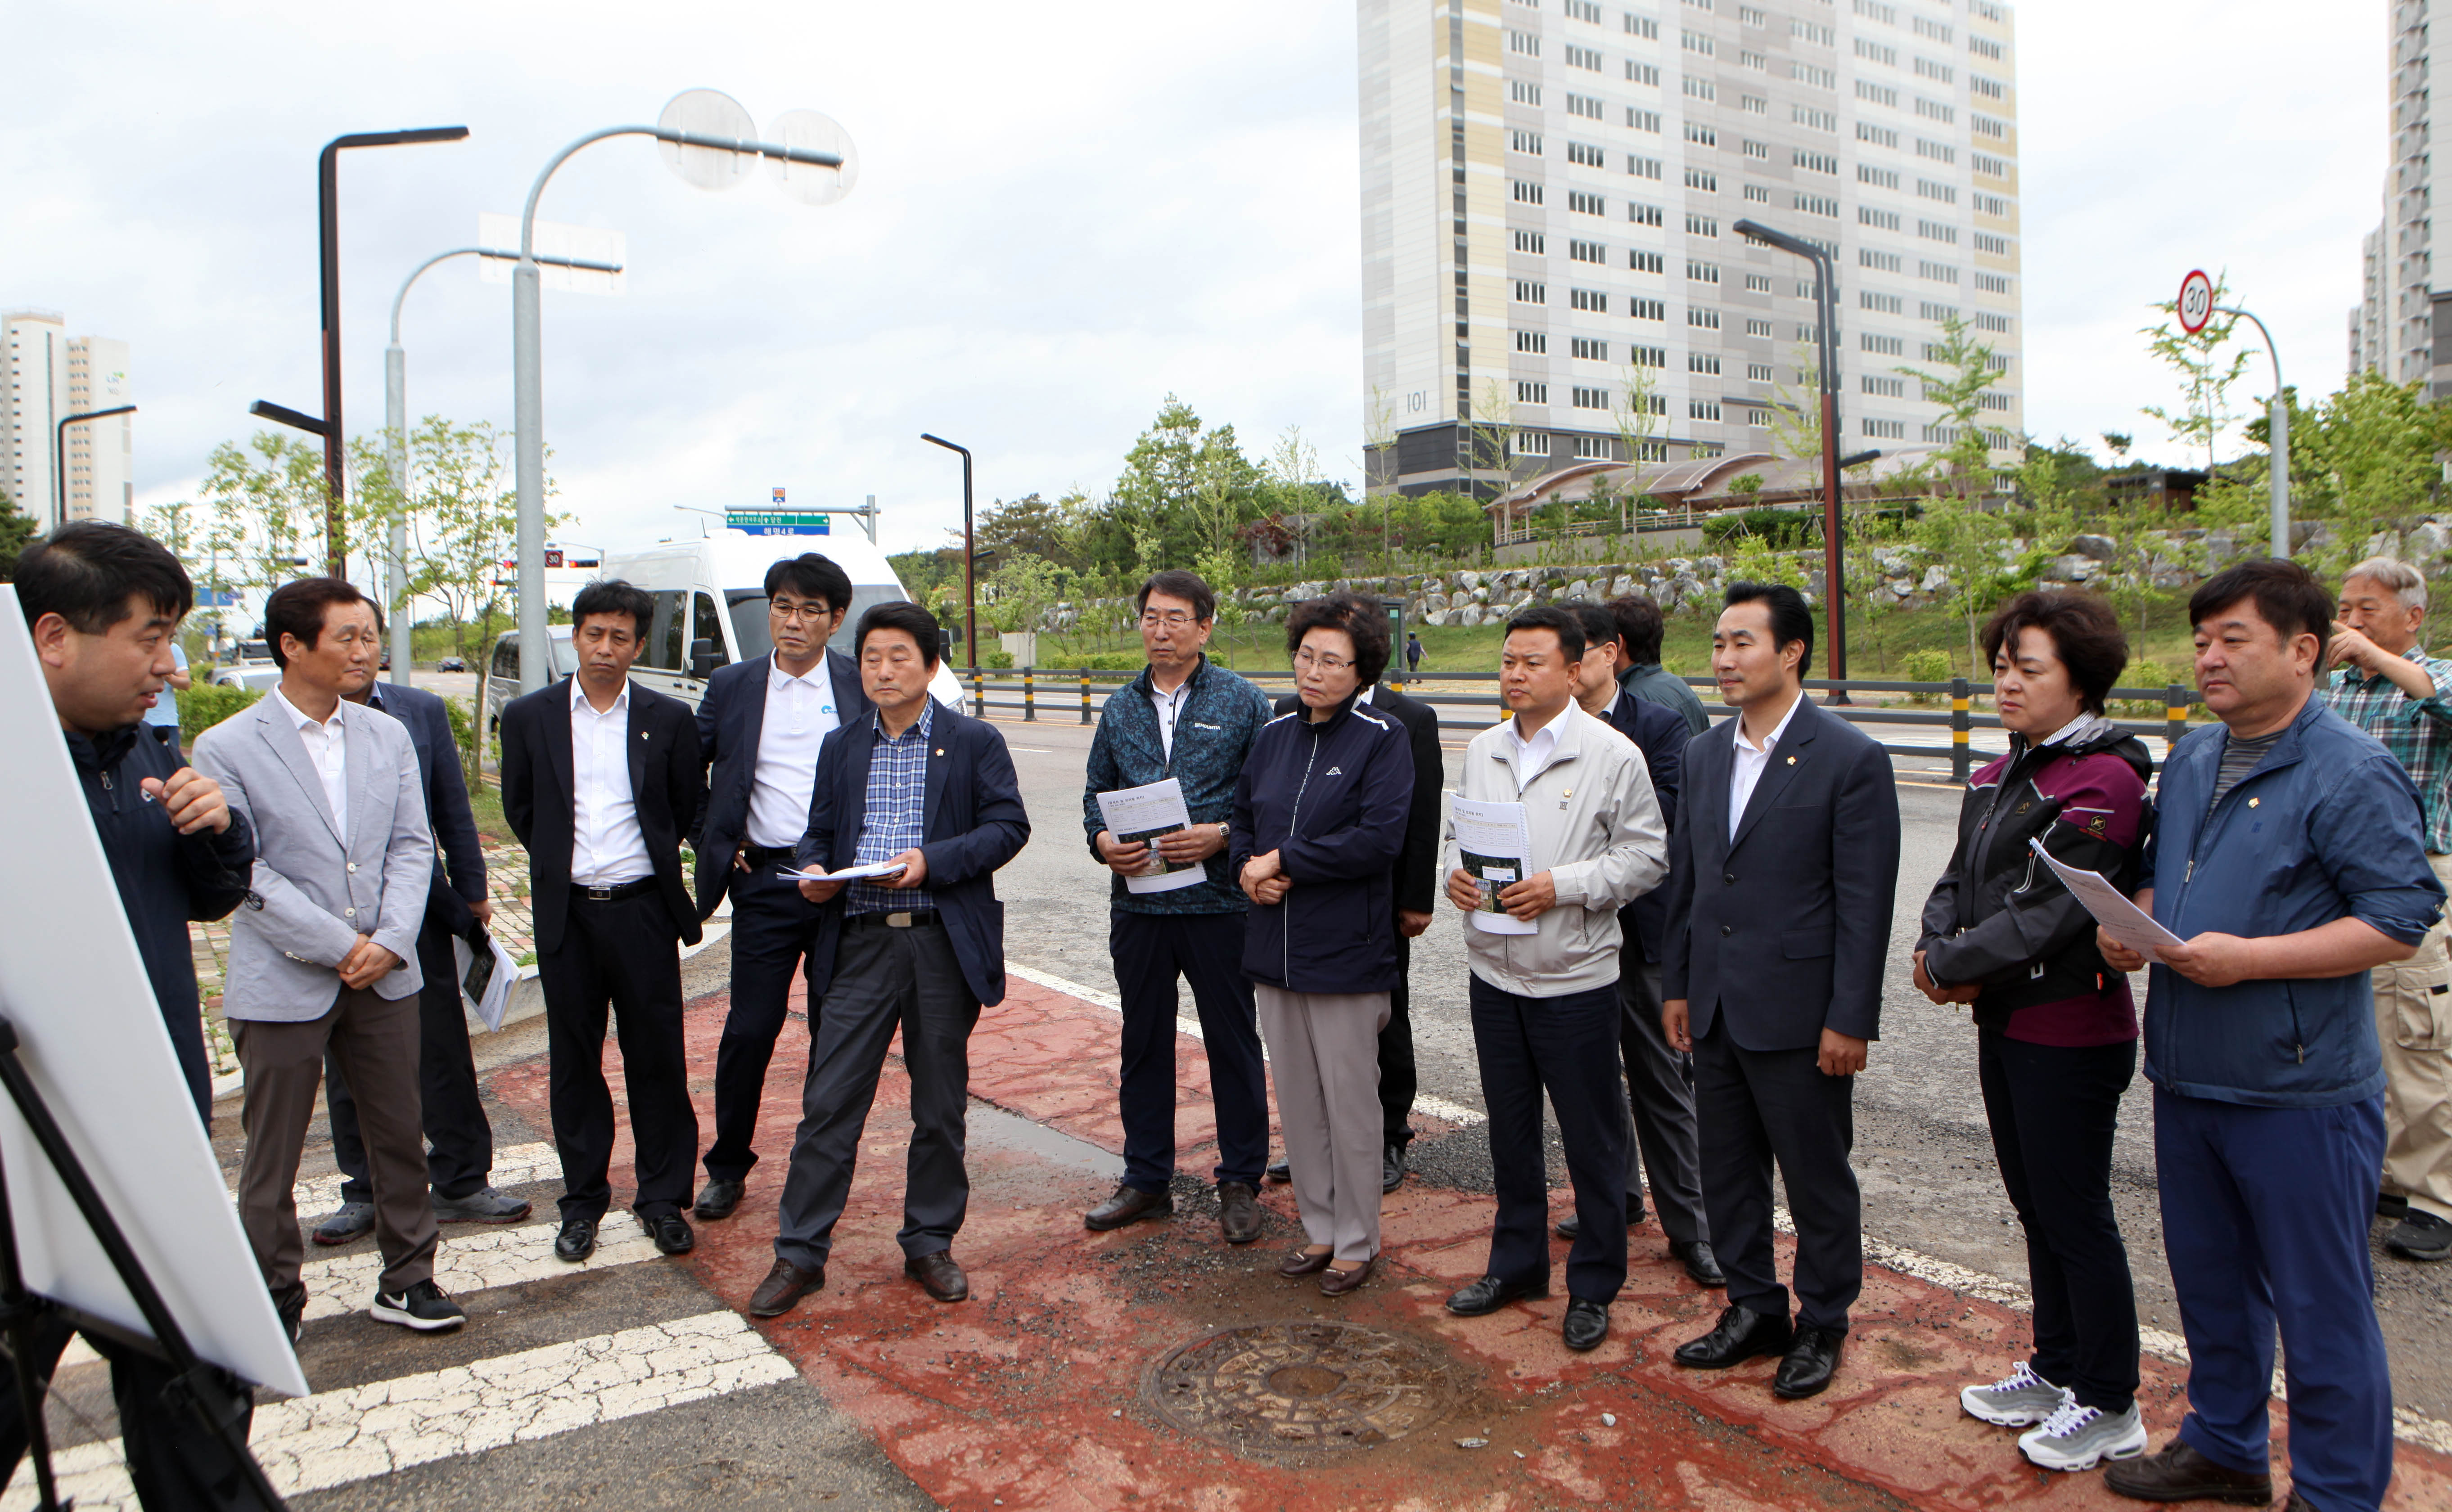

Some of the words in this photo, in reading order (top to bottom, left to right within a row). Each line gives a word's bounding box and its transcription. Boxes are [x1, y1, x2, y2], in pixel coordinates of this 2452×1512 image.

[2186, 286, 2206, 316] 30
[1407, 390, 1426, 413] 101
[549, 554, 559, 563] 30
